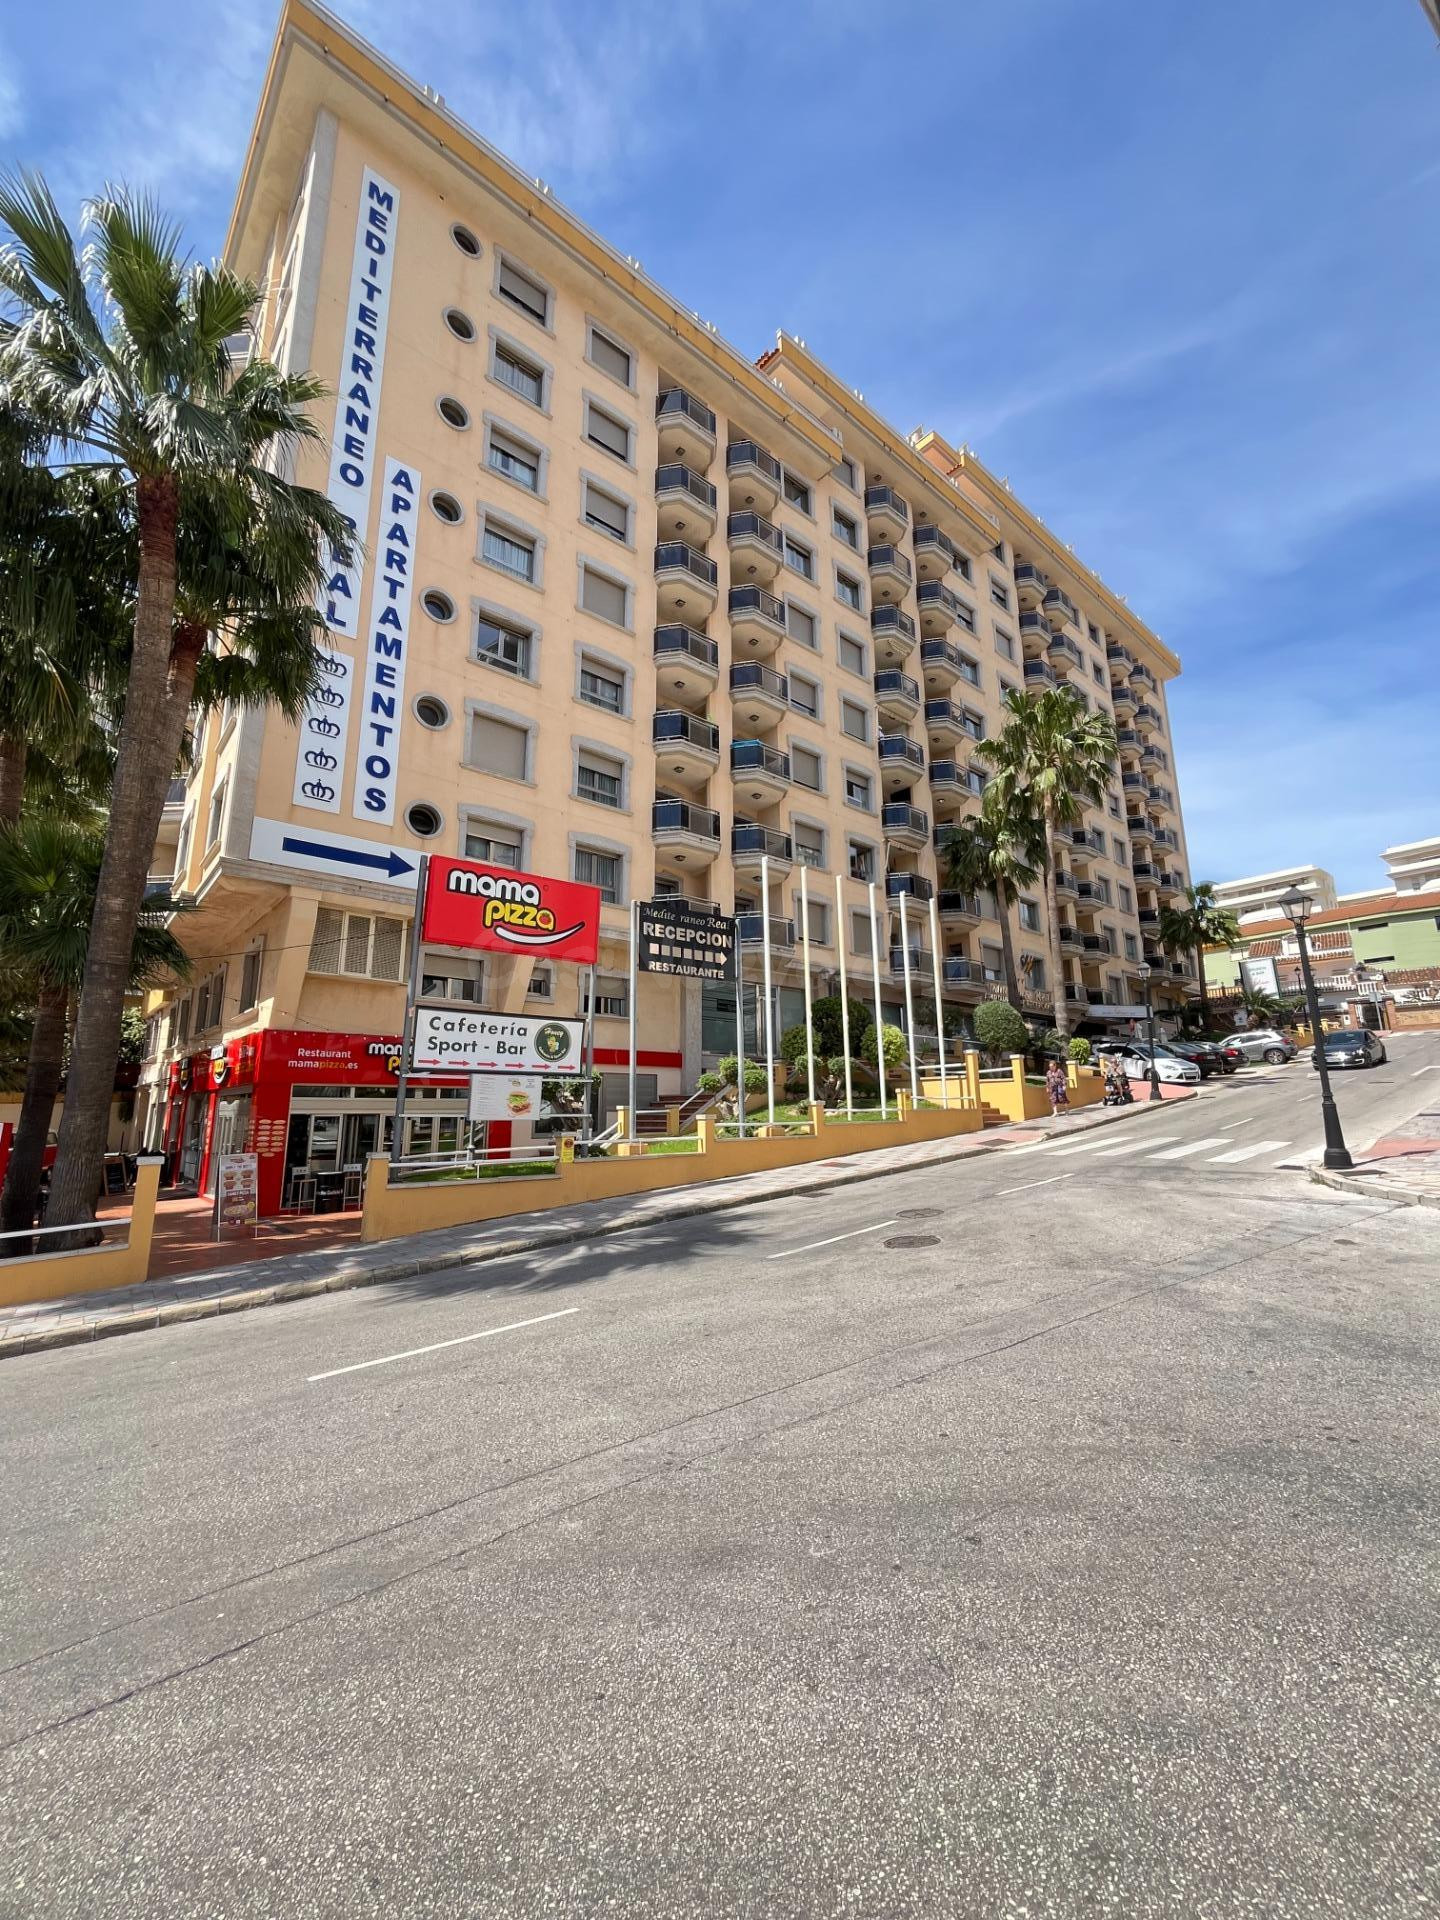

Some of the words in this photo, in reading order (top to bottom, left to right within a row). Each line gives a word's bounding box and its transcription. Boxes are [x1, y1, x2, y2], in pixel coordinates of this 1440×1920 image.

[339, 180, 394, 488] MEDITERRANEO
[364, 469, 414, 813] APARTAMENTOS
[449, 869, 540, 906] mama
[485, 900, 555, 931] pizza
[643, 922, 733, 949] RECEPCION
[648, 960, 725, 979] RESTAURANTE
[429, 1016, 528, 1037] Cafetería
[297, 1047, 352, 1059] Restaurant
[427, 1036, 478, 1056] Sport
[496, 1041, 527, 1055] Bar
[288, 1059, 359, 1070] mamapizza.es
